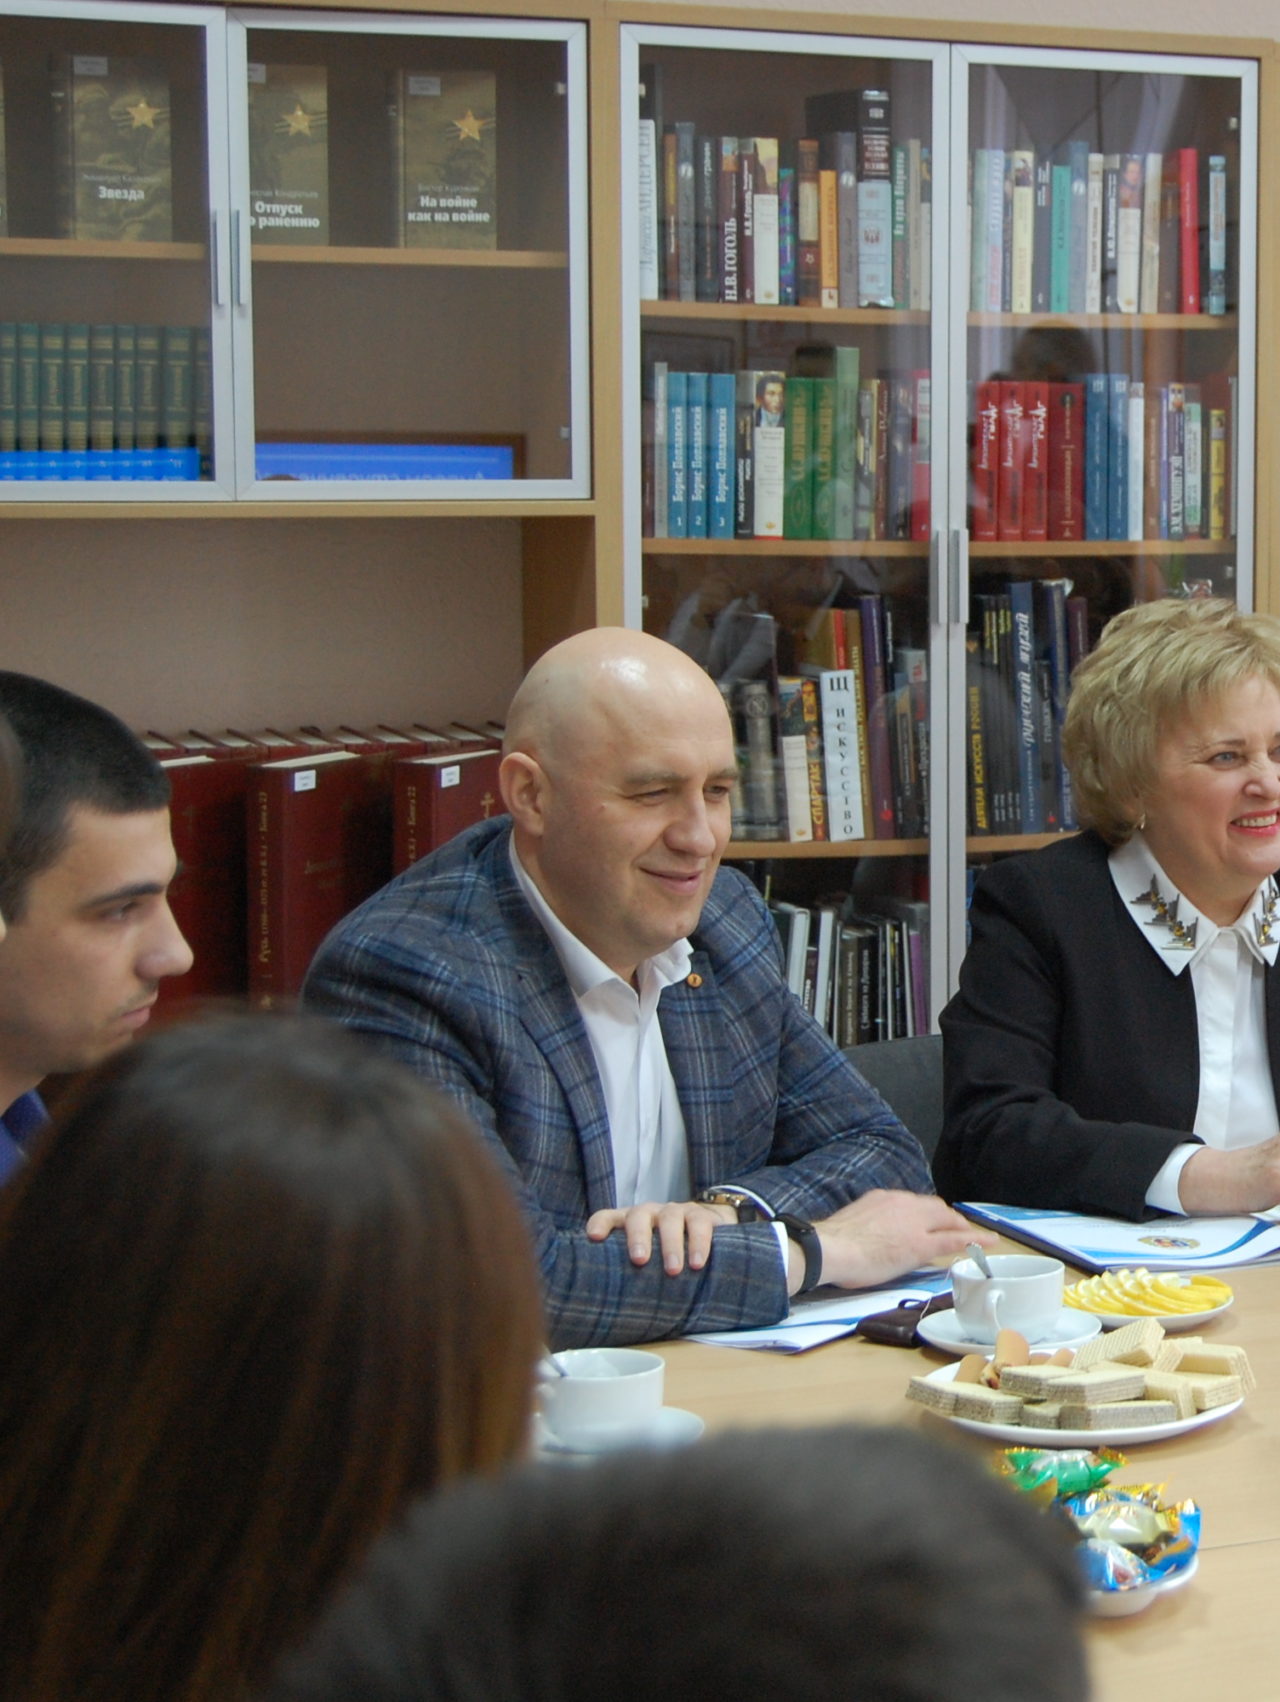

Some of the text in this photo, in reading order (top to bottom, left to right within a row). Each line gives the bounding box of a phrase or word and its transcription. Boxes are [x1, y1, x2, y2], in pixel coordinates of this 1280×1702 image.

[98, 186, 145, 201] Звезда
[420, 195, 478, 208] На войне
[255, 201, 304, 217] Отпуск
[407, 209, 491, 222] как на войне
[258, 217, 320, 230] ранению
[725, 218, 738, 270] ГОГОЛЬ
[672, 472, 685, 502] Борис
[691, 471, 704, 501] Борис
[715, 472, 728, 502] Борис
[829, 676, 850, 693] Щ
[969, 686, 988, 828] ДЕЯТЕЛИ ИСКУССТВ РОССИИ
